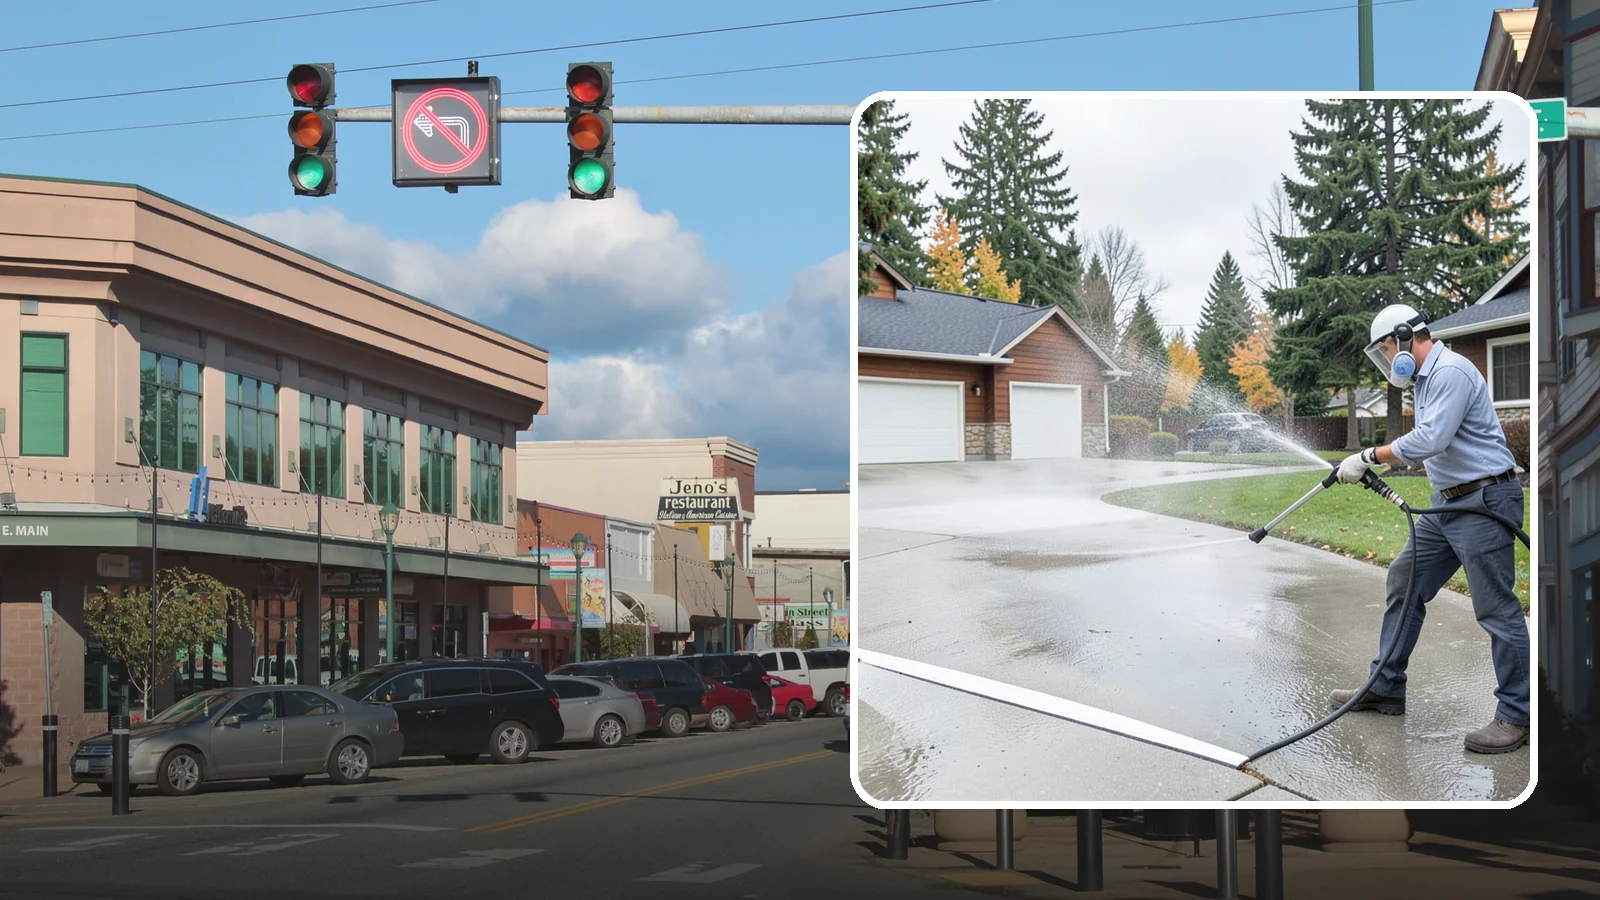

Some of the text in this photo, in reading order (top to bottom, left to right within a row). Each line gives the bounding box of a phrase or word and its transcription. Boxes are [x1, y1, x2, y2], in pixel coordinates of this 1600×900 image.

[670, 480, 727, 494] Jeno's
[666, 496, 731, 509] restaurant
[659, 510, 681, 520] Italian
[686, 509, 714, 519] American
[715, 509, 737, 519] Cuisine
[2, 525, 49, 536] E. MAIN
[797, 607, 829, 616] Street
